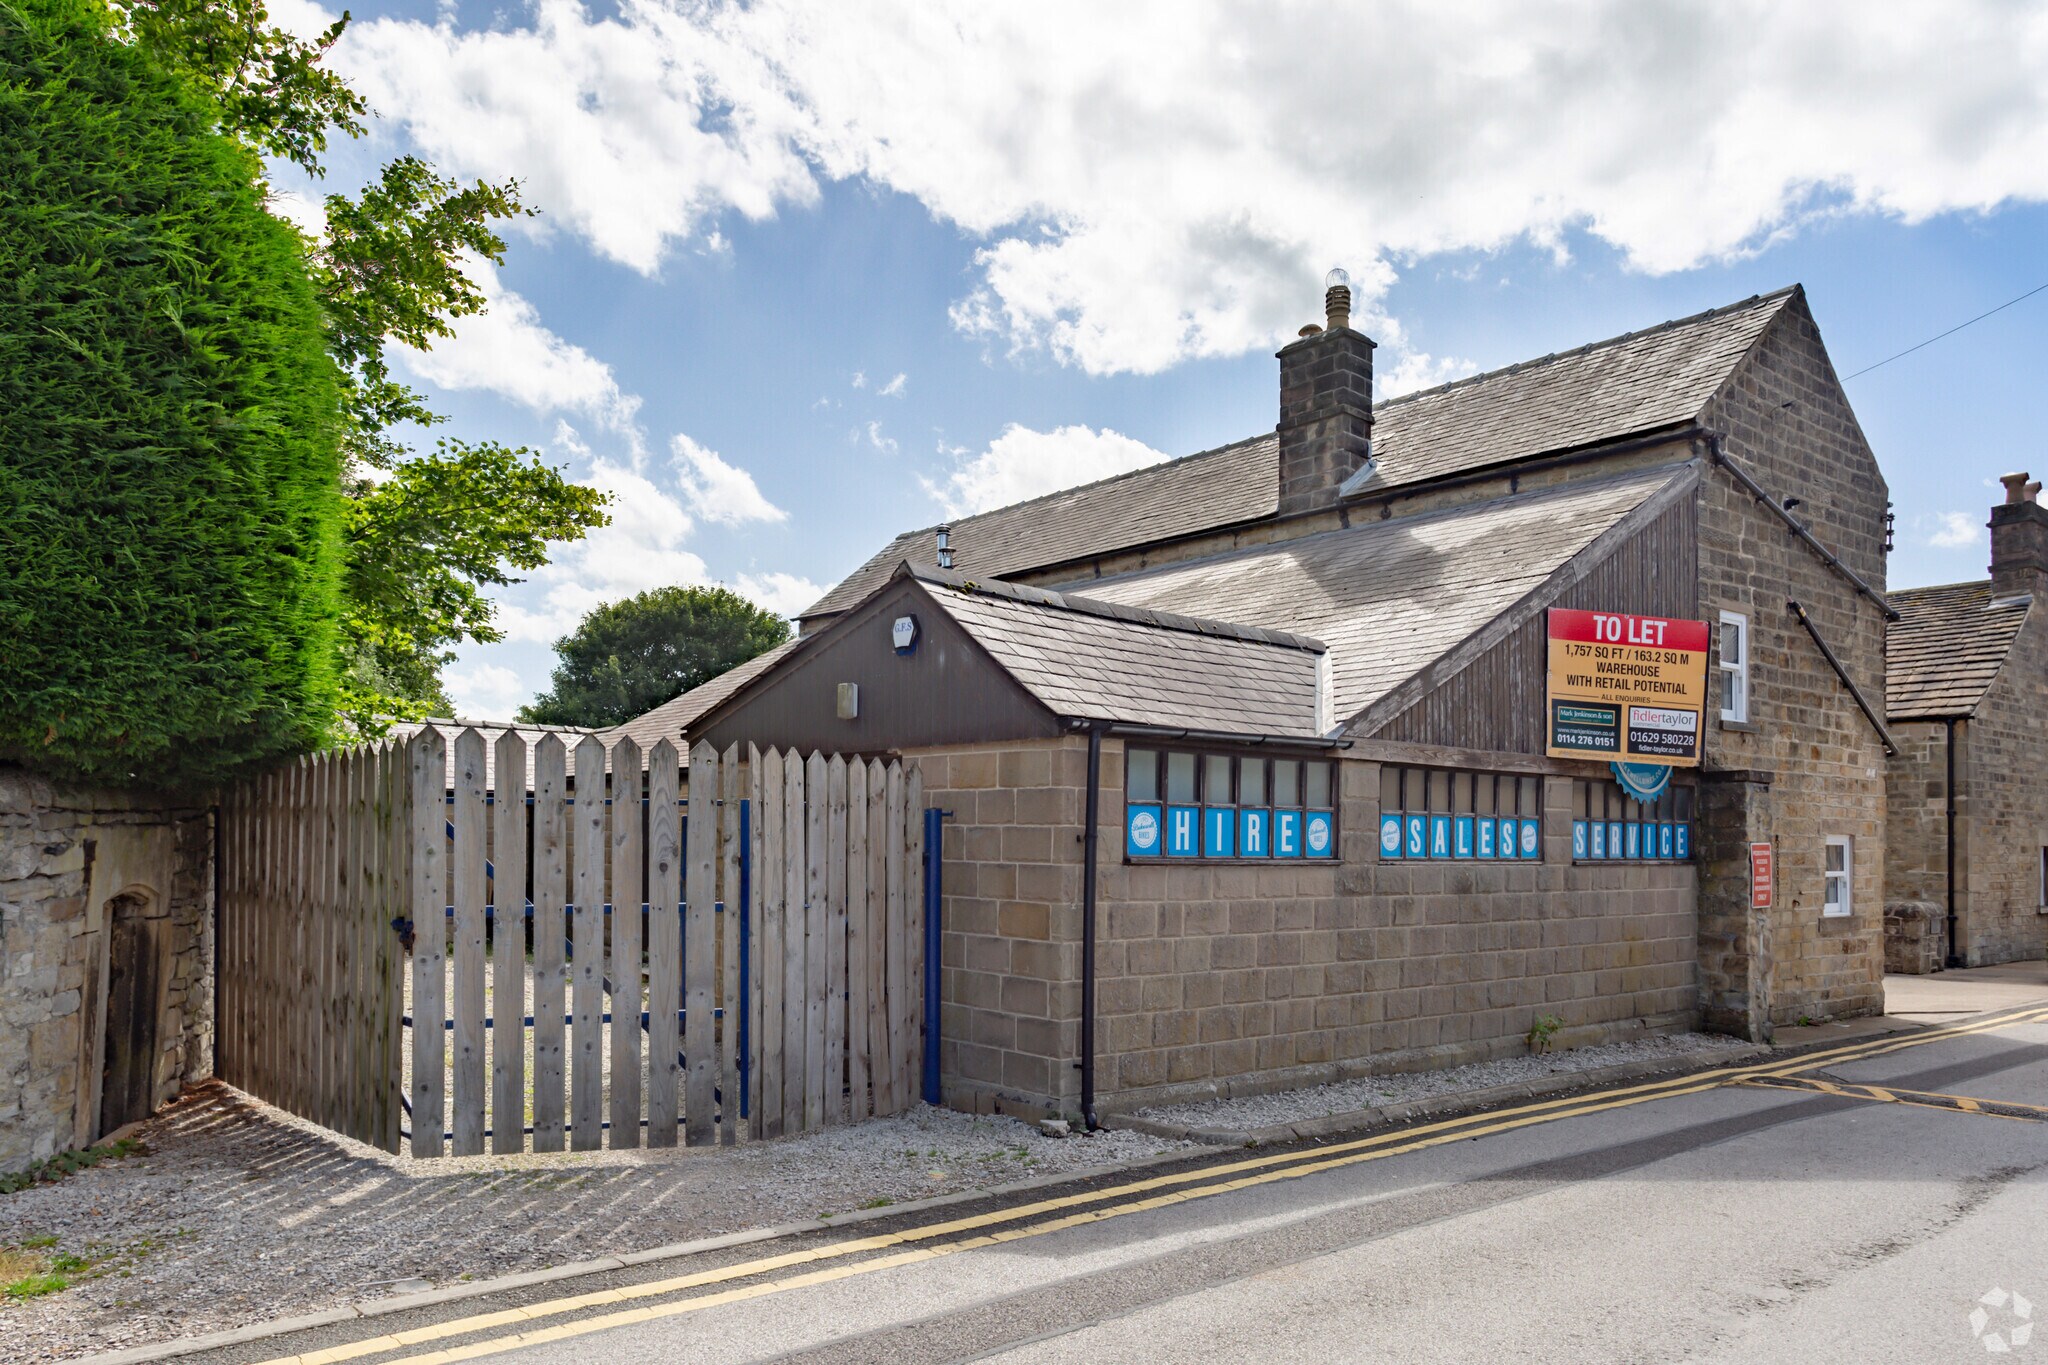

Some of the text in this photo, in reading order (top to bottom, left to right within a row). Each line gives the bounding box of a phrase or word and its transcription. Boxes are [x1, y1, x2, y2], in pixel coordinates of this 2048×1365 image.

[1593, 615, 1667, 645] TO LET
[1565, 644, 1689, 665] 1,757 SQ FT / 163.2 SQ M
[1596, 662, 1660, 678] WAREHOUSE
[1567, 674, 1687, 695] WITH RETAIL POTENTIAL
[1615, 695, 1651, 704] ENQUIRIES
[1574, 710, 1597, 718] Jenkinson
[1633, 709, 1693, 727] fidlertaylor
[1557, 727, 1615, 737] www.markjenkinson.co.uk
[1557, 733, 1614, 747] 0114 276 0151
[1630, 731, 1694, 746] 01629 580228
[1638, 744, 1683, 754] fidler-taylor.co.uk
[1176, 811, 1293, 852] HIRE
[1410, 819, 1513, 855] SALES
[1575, 825, 1685, 856] SERVICE
